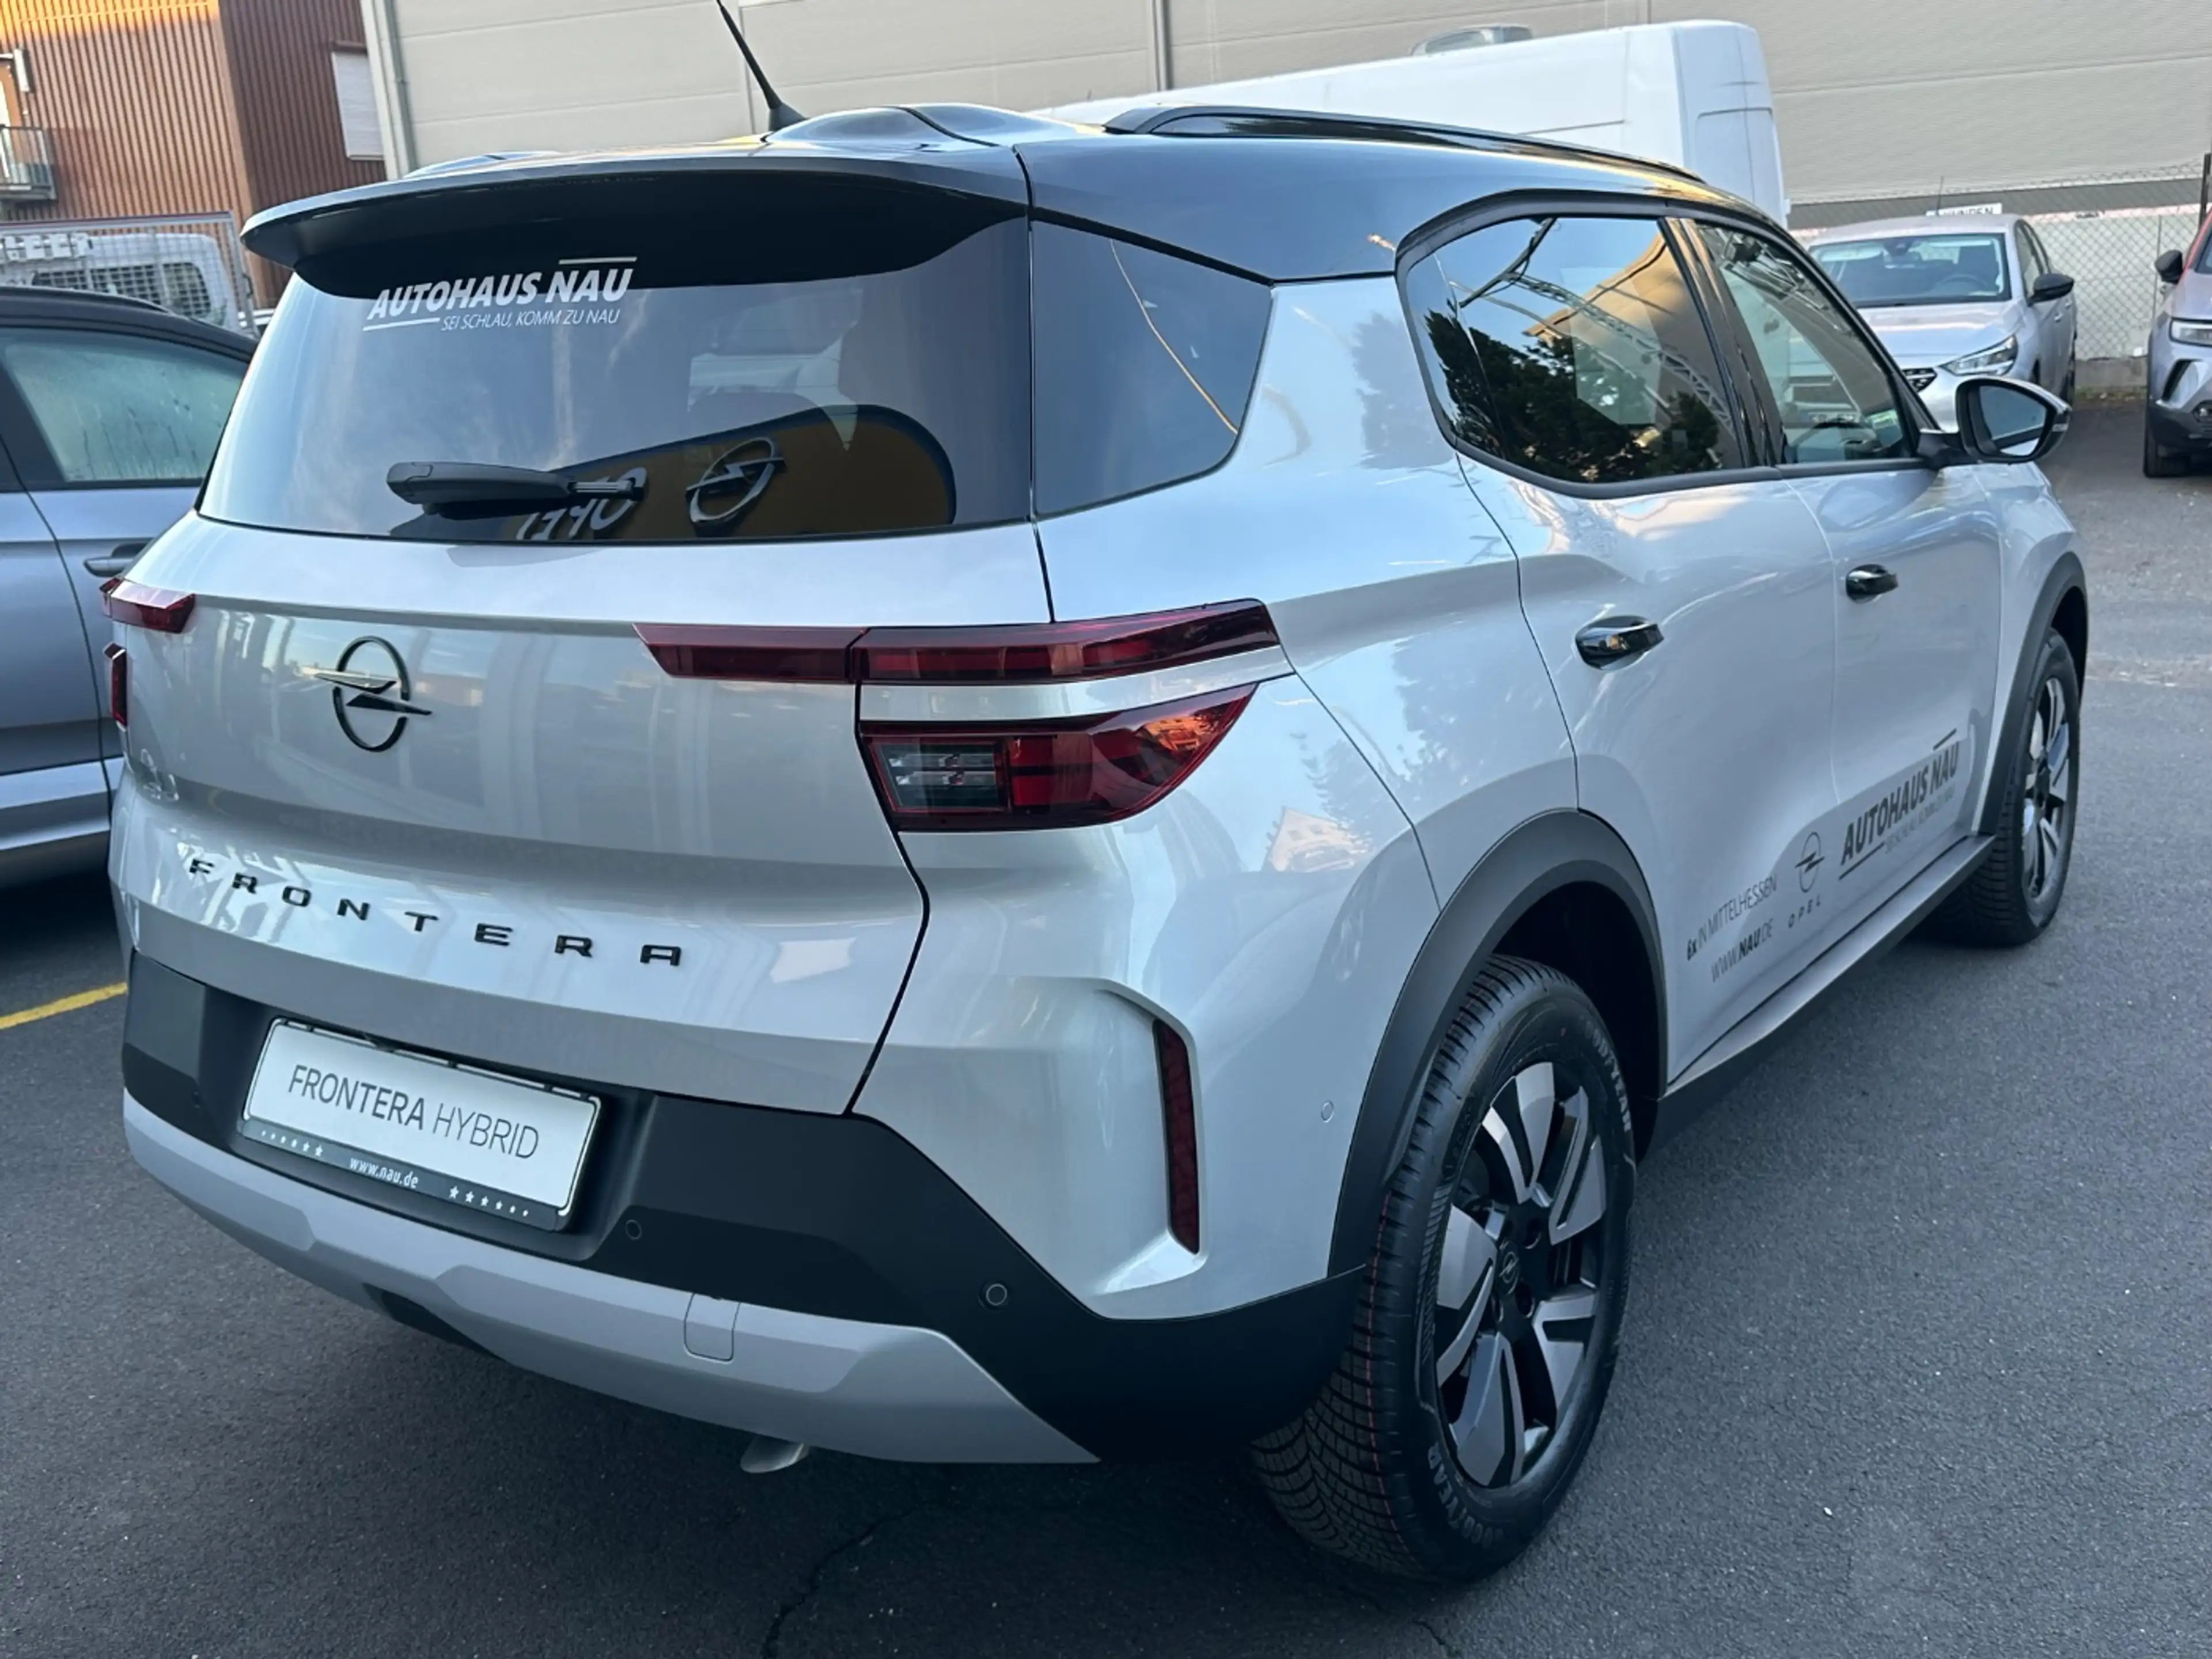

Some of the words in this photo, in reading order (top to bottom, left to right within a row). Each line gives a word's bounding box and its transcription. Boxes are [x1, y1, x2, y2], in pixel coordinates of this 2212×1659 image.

[366, 272, 541, 320] AUTOHAUS
[545, 268, 634, 304] NAU
[441, 315, 461, 331] SEI
[461, 312, 512, 330] SCHLAU,
[515, 311, 561, 326] KOMM
[559, 310, 582, 325] ZU
[586, 309, 620, 324] NAU
[1840, 766, 1928, 866] AUTOHAUS
[1930, 740, 1960, 794] NAU
[190, 859, 681, 967] FRONTERA
[1698, 924, 1707, 949] IN
[1708, 873, 1778, 941] MITTELHESSEN
[1787, 892, 1821, 929] OPEL
[289, 1064, 426, 1130] FRONTERA
[433, 1102, 540, 1159] HYBRID
[350, 1157, 419, 1189] www.nau.de
